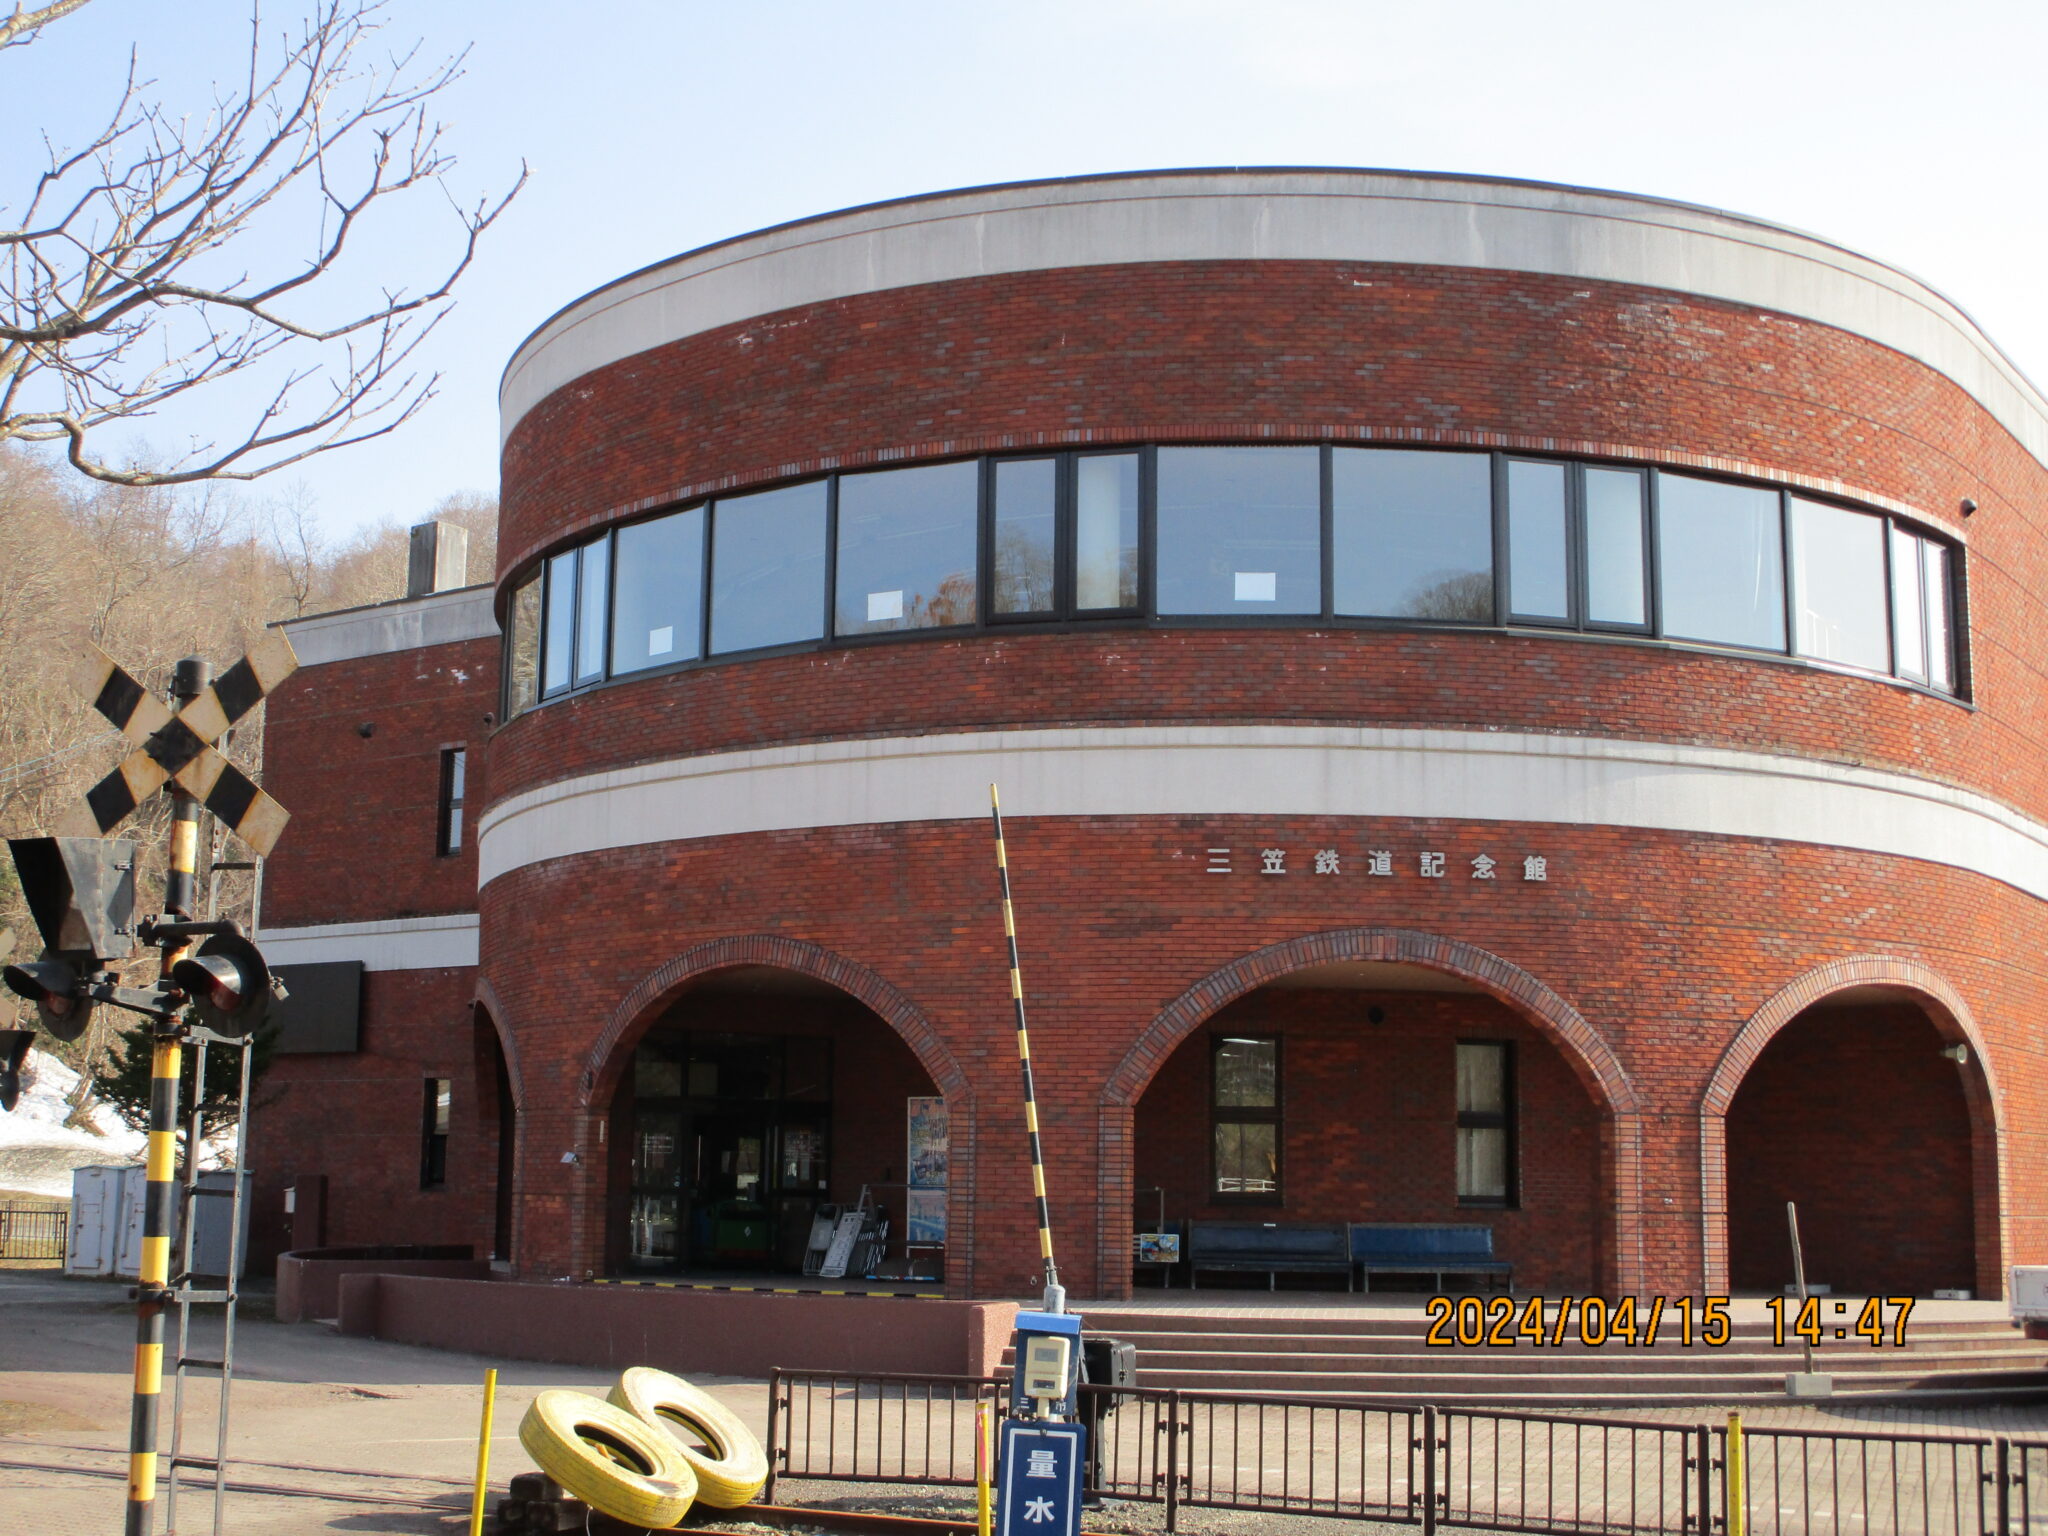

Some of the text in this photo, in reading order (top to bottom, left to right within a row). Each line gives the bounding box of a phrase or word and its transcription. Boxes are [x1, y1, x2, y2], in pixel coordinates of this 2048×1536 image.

[1206, 848, 1547, 881] 三笠鉄道記念館
[1023, 1449, 1058, 1523] 量水
